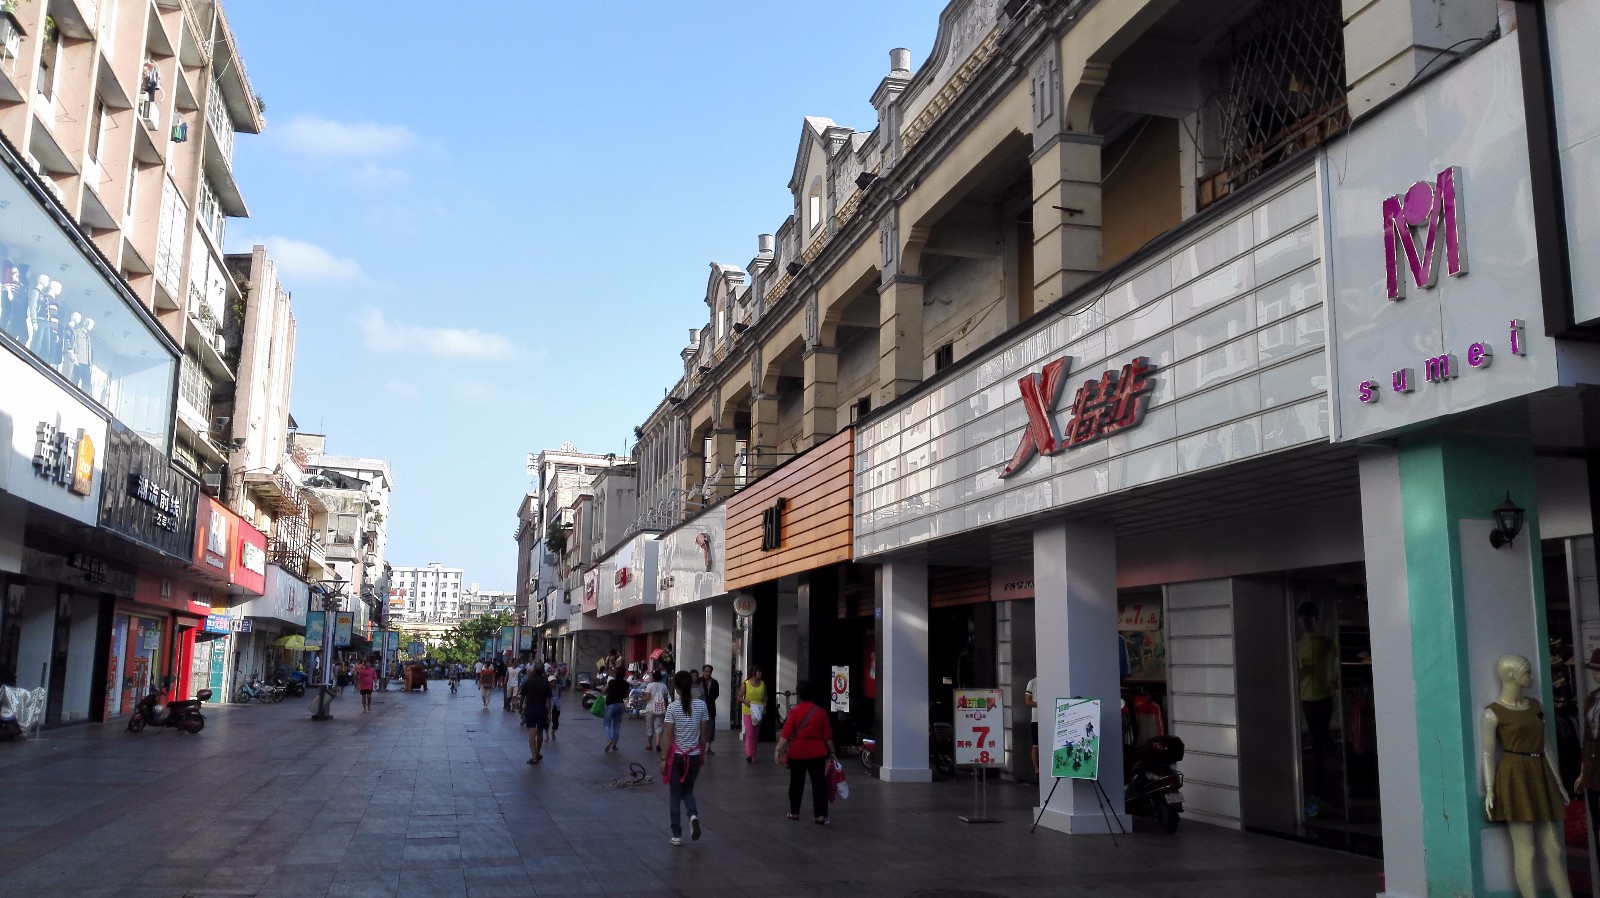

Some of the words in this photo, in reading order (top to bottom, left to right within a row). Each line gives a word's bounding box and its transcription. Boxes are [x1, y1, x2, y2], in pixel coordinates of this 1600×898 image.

[1359, 318, 1526, 403] sumei
[137, 474, 180, 518] 潮流前线
